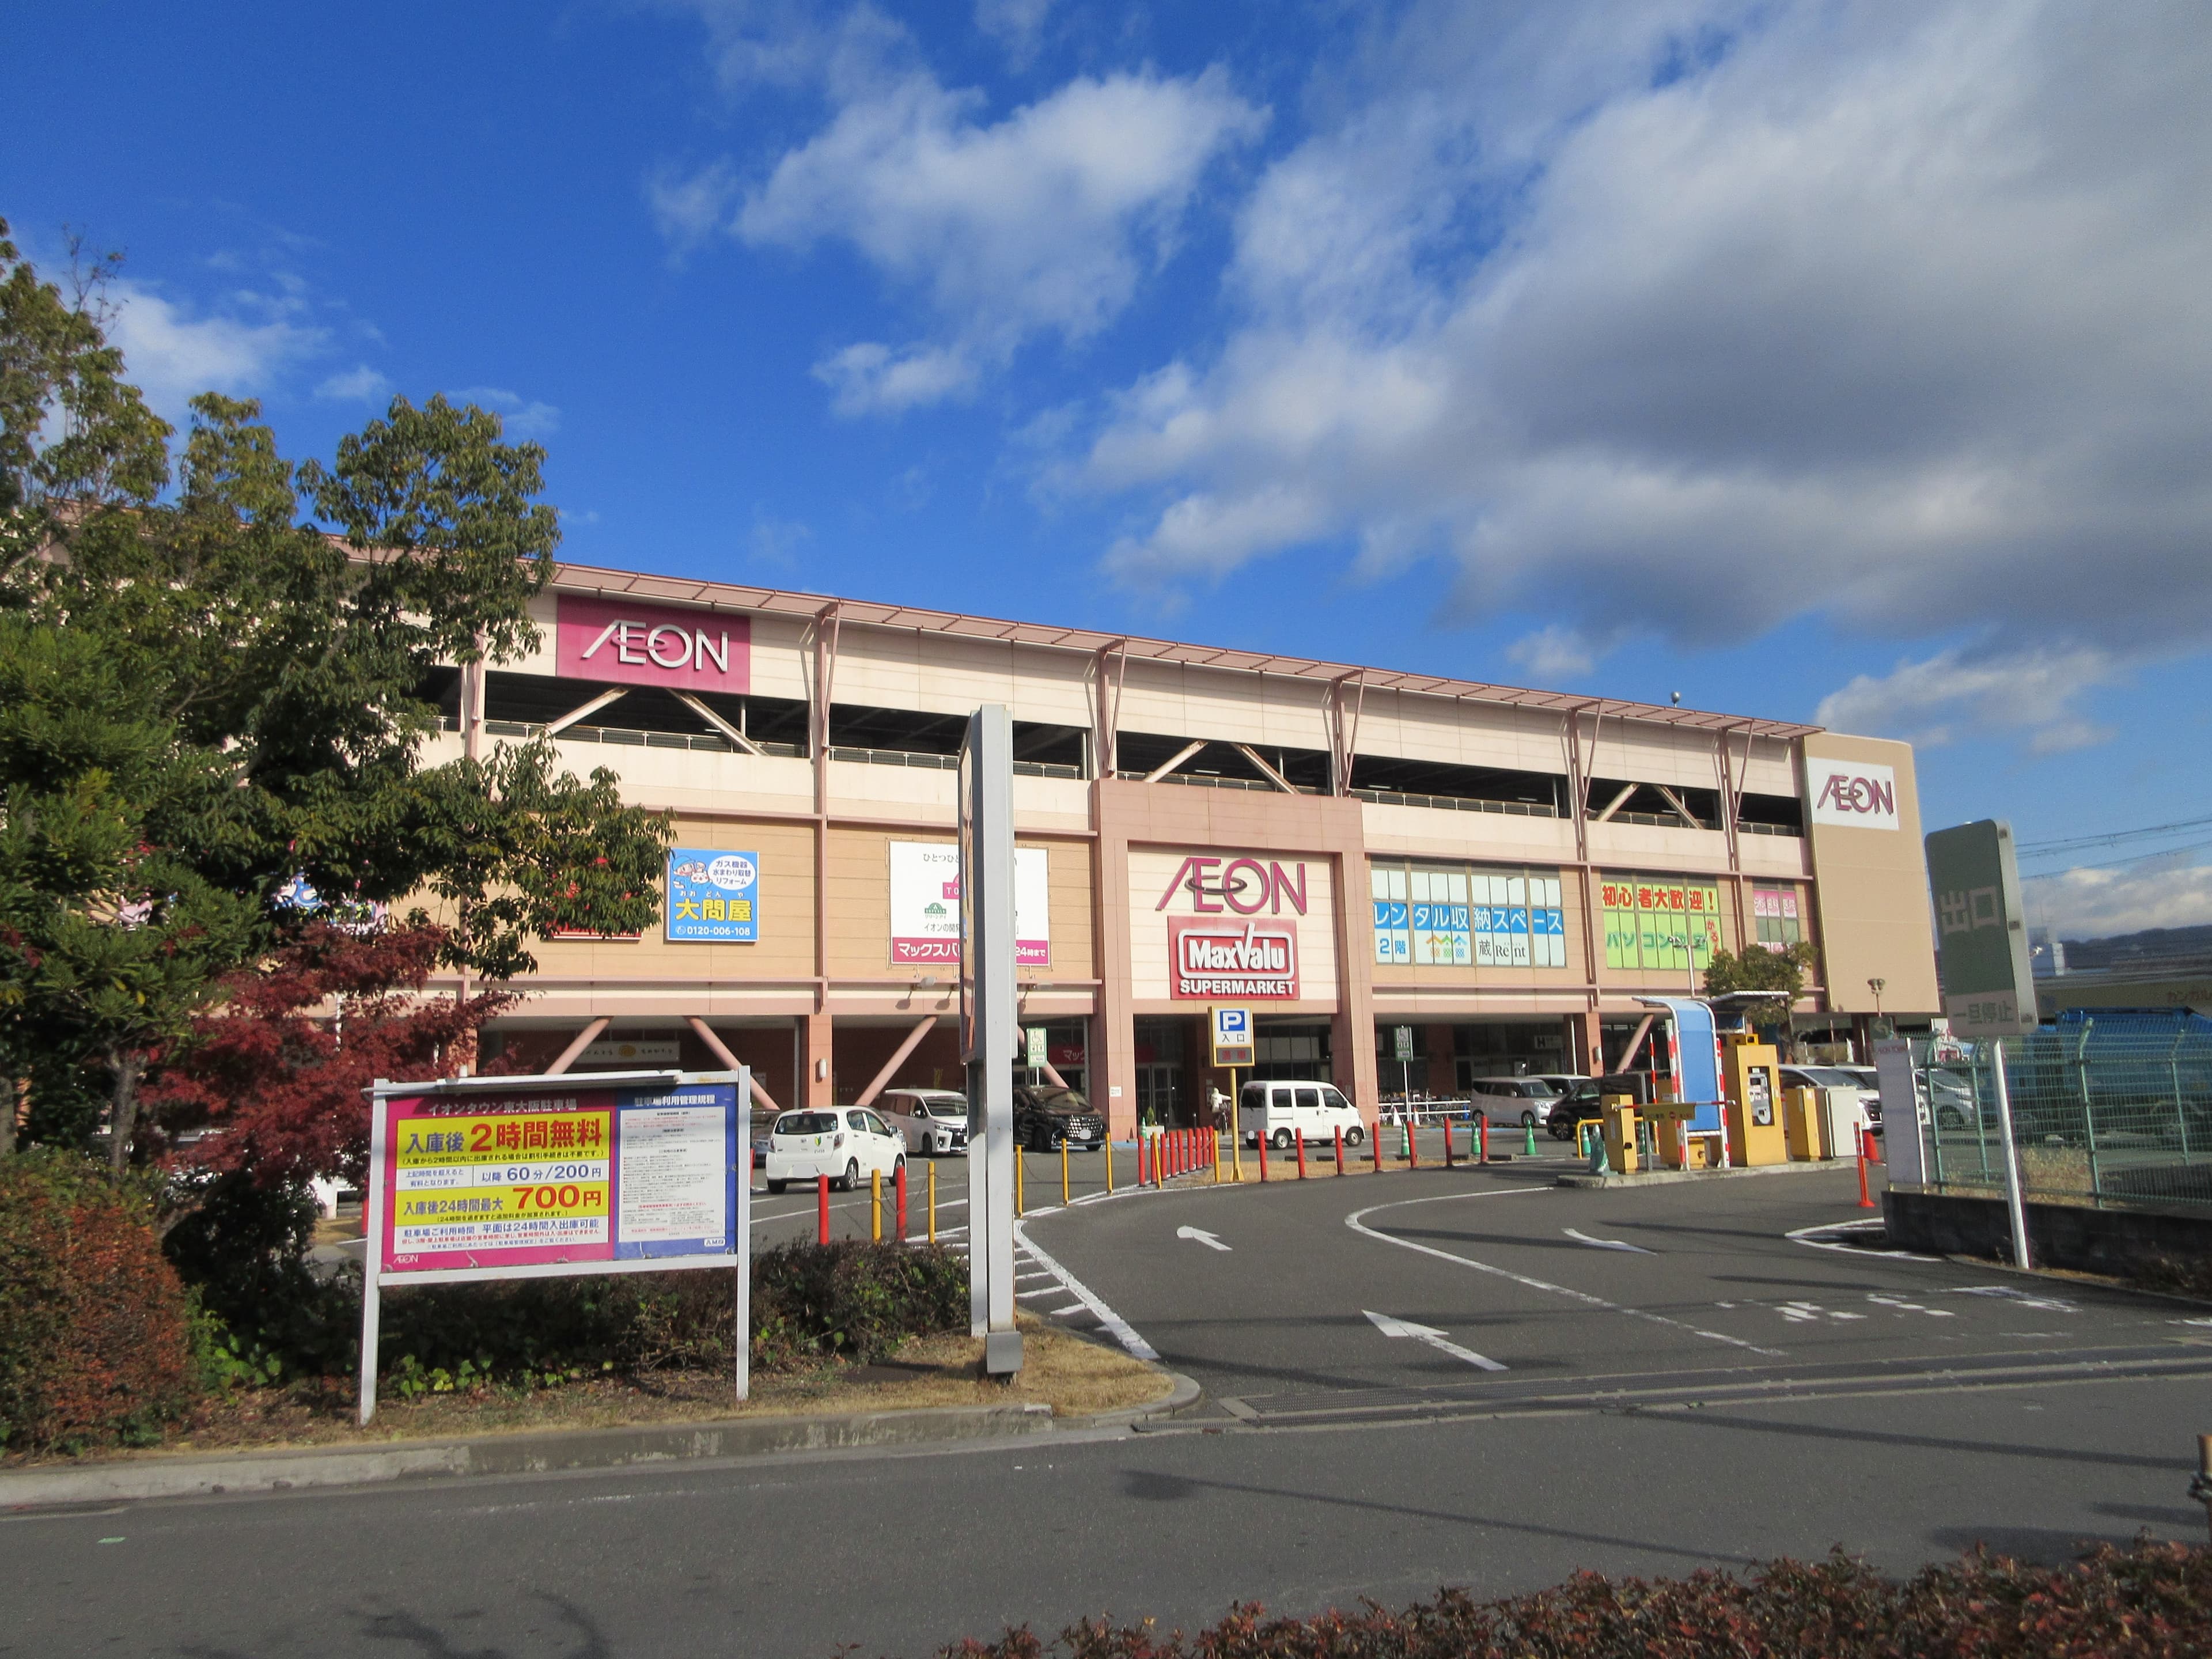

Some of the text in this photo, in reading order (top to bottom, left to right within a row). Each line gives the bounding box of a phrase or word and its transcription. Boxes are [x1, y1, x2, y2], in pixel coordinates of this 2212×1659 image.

[713, 869, 751, 877] 水まわり取替
[715, 859, 748, 869] ガス機器
[716, 877, 747, 885] リフォーム
[675, 898, 752, 922] 大問屋
[1374, 903, 1563, 932] レンタル収納スペース
[1940, 887, 2001, 934] 出口
[687, 926, 751, 937] 0120-006-108
[1187, 923, 1286, 970] MaxValu
[1380, 938, 1406, 955] 2階
[1179, 979, 1296, 995] SUPERMARKET
[1223, 1012, 1242, 1030] P
[1222, 1033, 1245, 1043] 入口
[429, 1098, 577, 1116] イオンタウン東大阪駐車場
[406, 1131, 465, 1154] 入庫後
[471, 1118, 602, 1152] 2時間無料
[482, 1172, 502, 1182] 以降
[403, 1184, 601, 1216] 入庫後24時間最大 700円
[404, 1219, 599, 1237] 駐車場ご利用時間 平面は24時間入出庫可能
